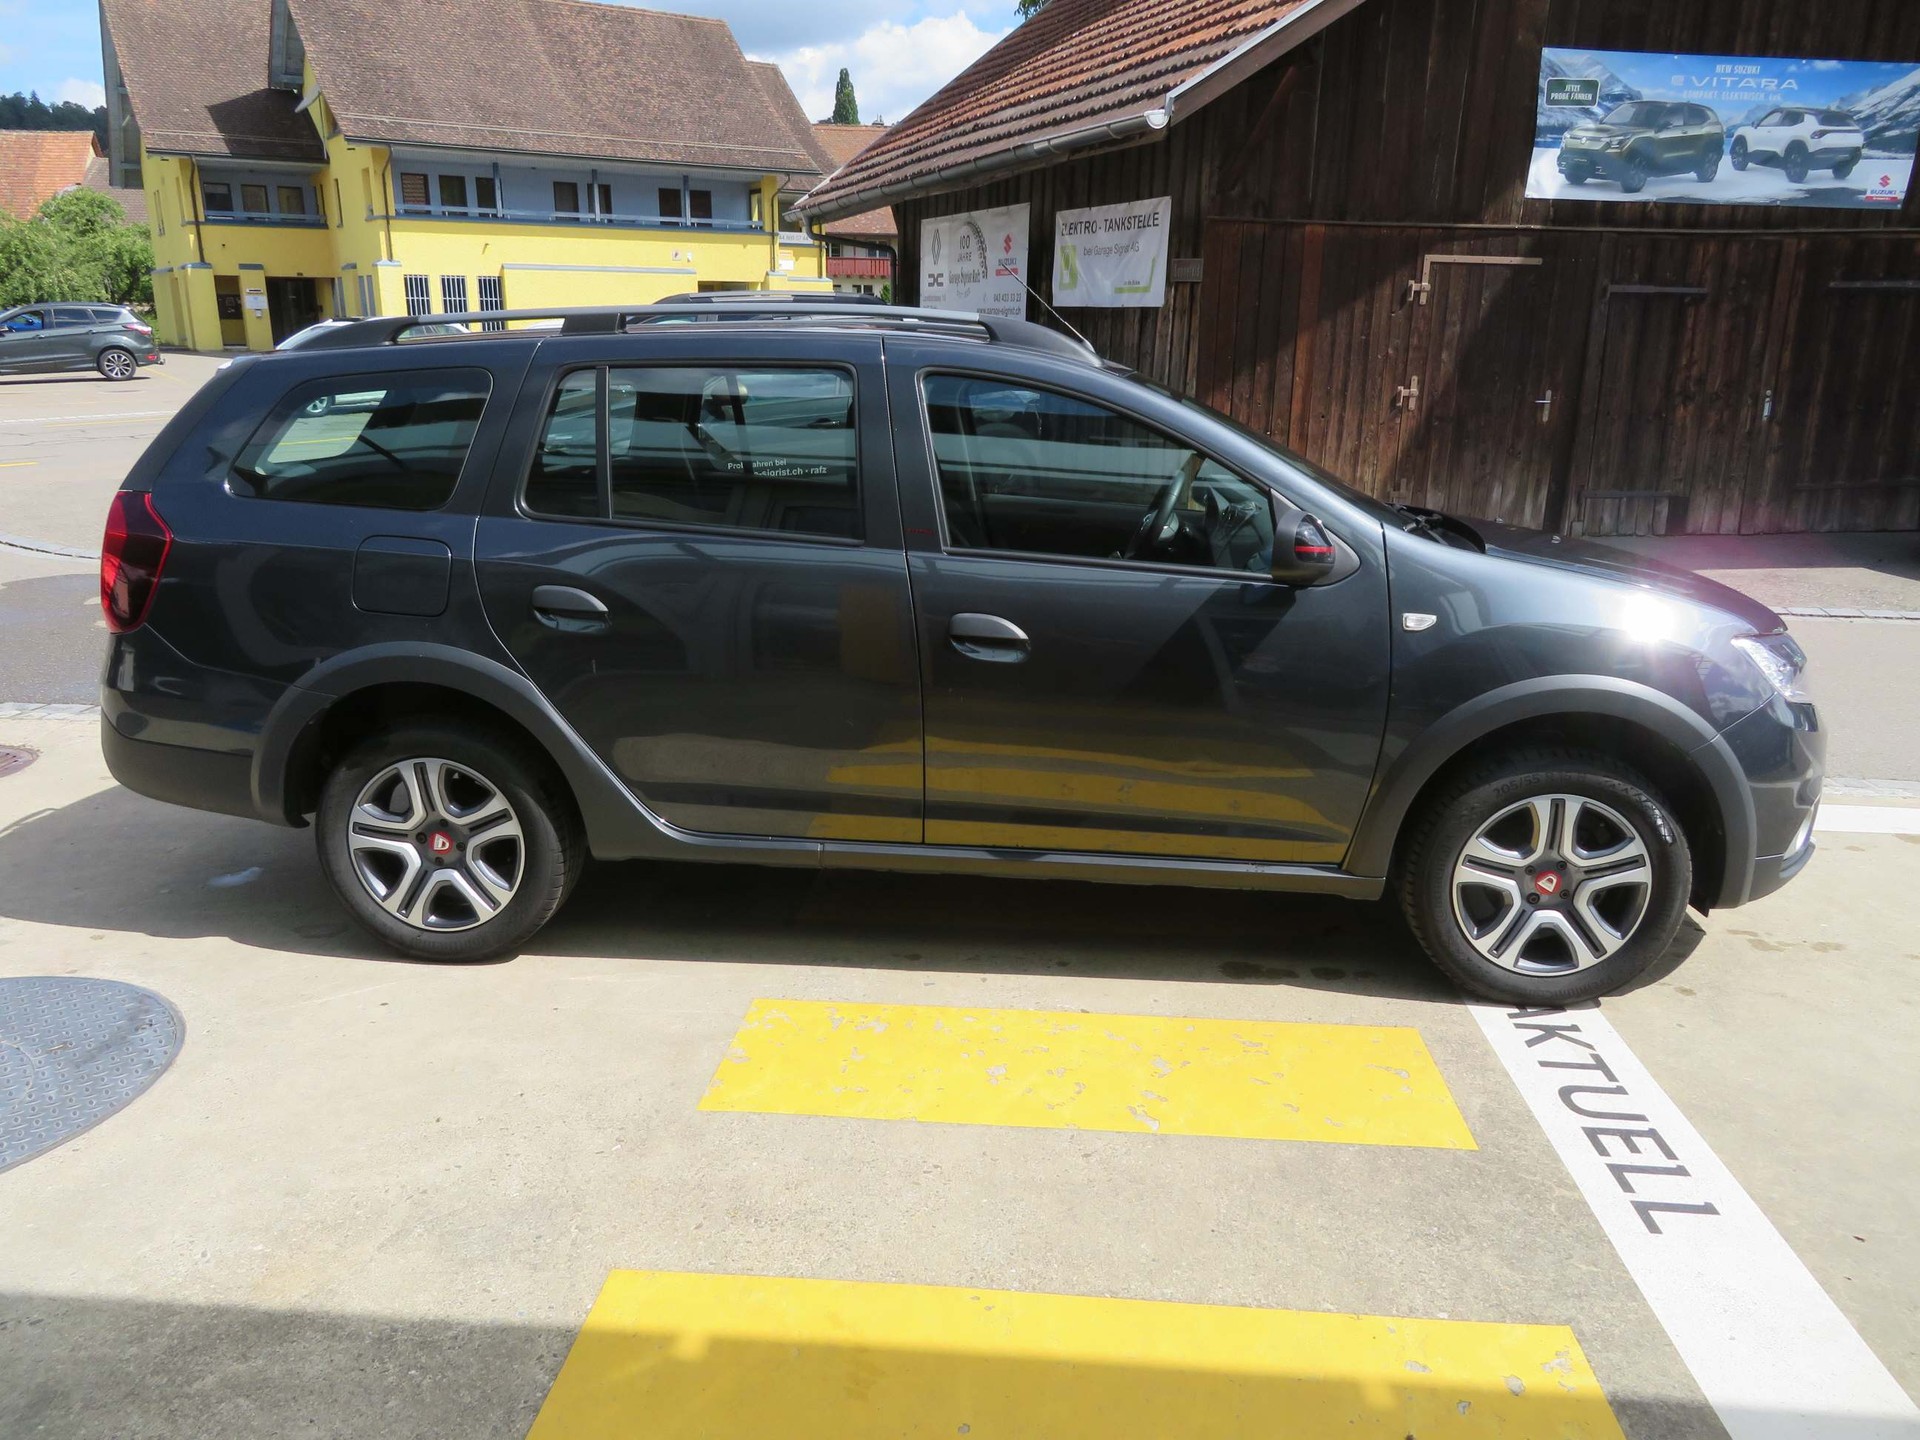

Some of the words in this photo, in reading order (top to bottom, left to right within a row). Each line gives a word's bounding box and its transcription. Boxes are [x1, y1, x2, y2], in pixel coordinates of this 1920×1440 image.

[1734, 65, 1761, 75] SUZUKI
[1564, 84, 1581, 92] JETZT
[1691, 76, 1798, 91] VITARA
[1550, 92, 1570, 100] PROBE
[1570, 93, 1593, 101] FAHREN
[1061, 220, 1098, 237] ELEKTRO
[1104, 212, 1160, 232] TANKSTELLE
[960, 234, 971, 250] 100
[1094, 245, 1113, 258] Garage
[1130, 240, 1140, 252] AG
[775, 458, 787, 467] bei
[810, 465, 828, 475] rafz
